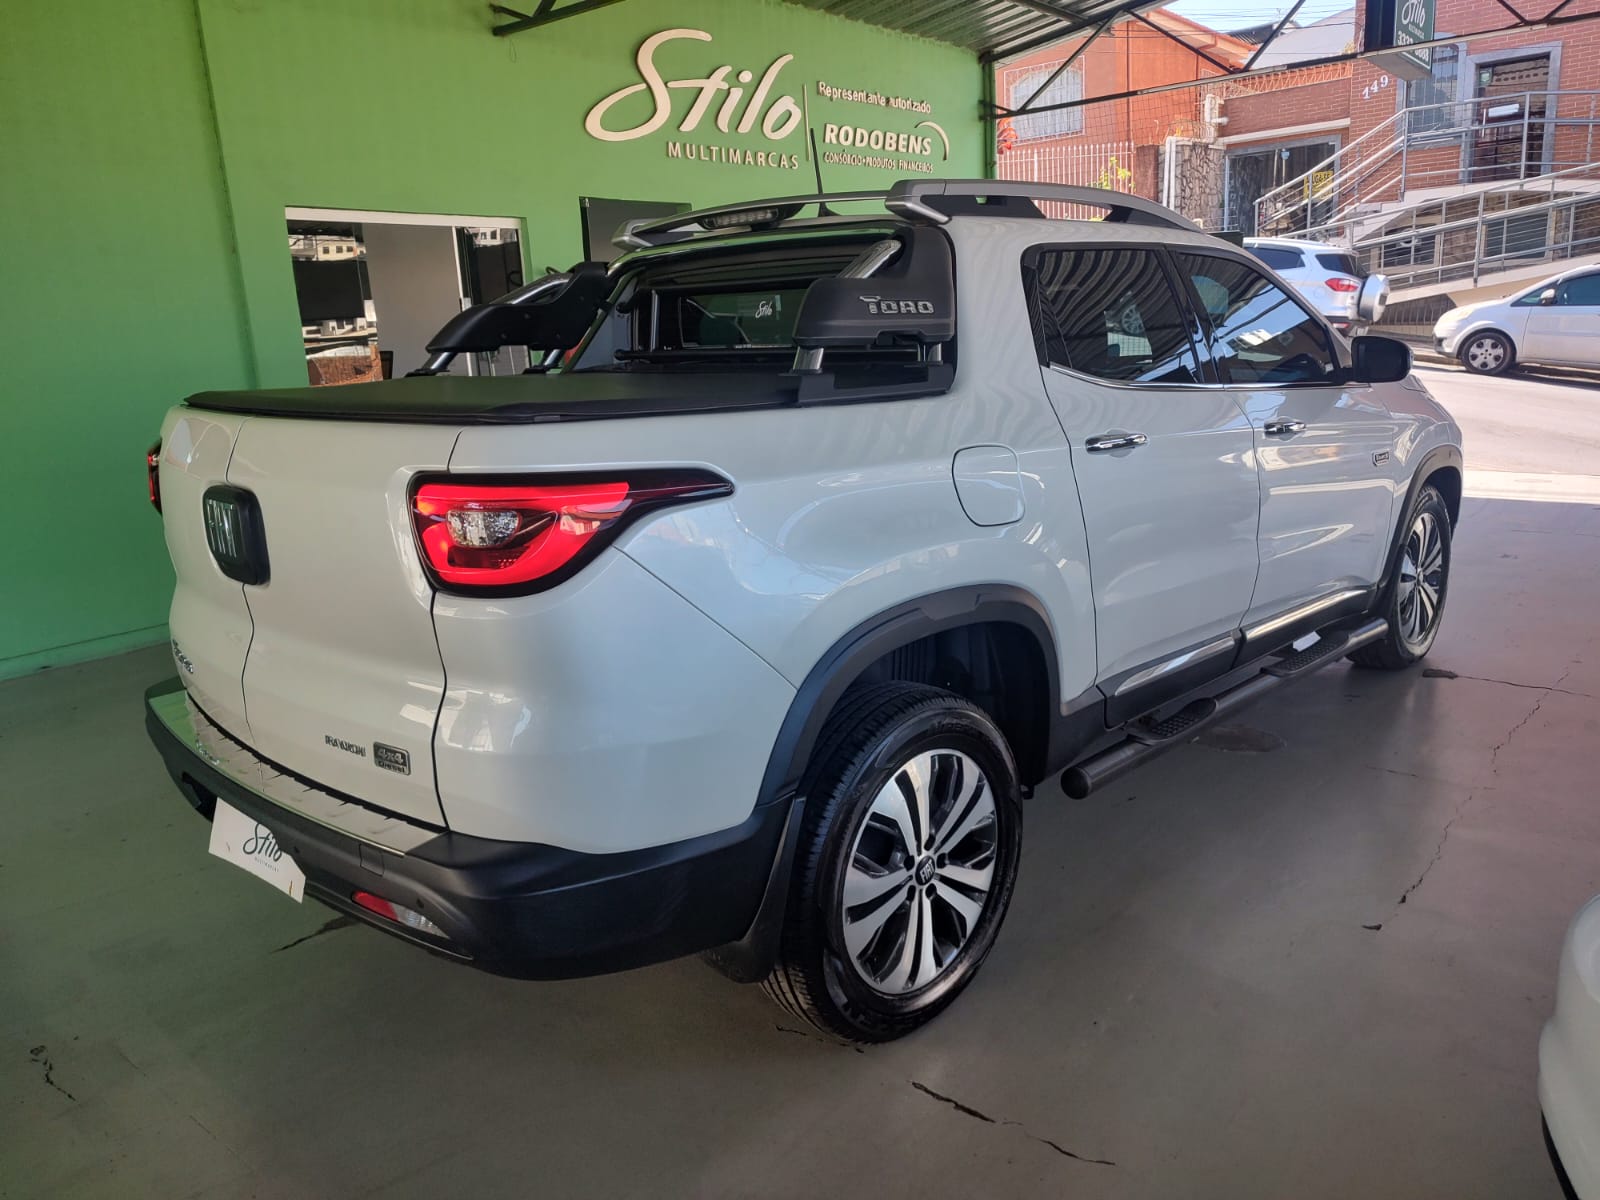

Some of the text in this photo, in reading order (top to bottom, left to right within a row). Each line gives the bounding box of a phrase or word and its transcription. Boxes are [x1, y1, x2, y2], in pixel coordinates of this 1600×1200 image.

[584, 28, 803, 142] Stilo
[817, 80, 932, 114] Representante autorizado
[1362, 74, 1389, 100] 149
[824, 122, 932, 156] RODOBENS
[667, 140, 800, 171] MULTIMARCAS
[859, 295, 935, 315] TORO
[243, 822, 283, 862] Stilo
[919, 858, 934, 884] FIAT
